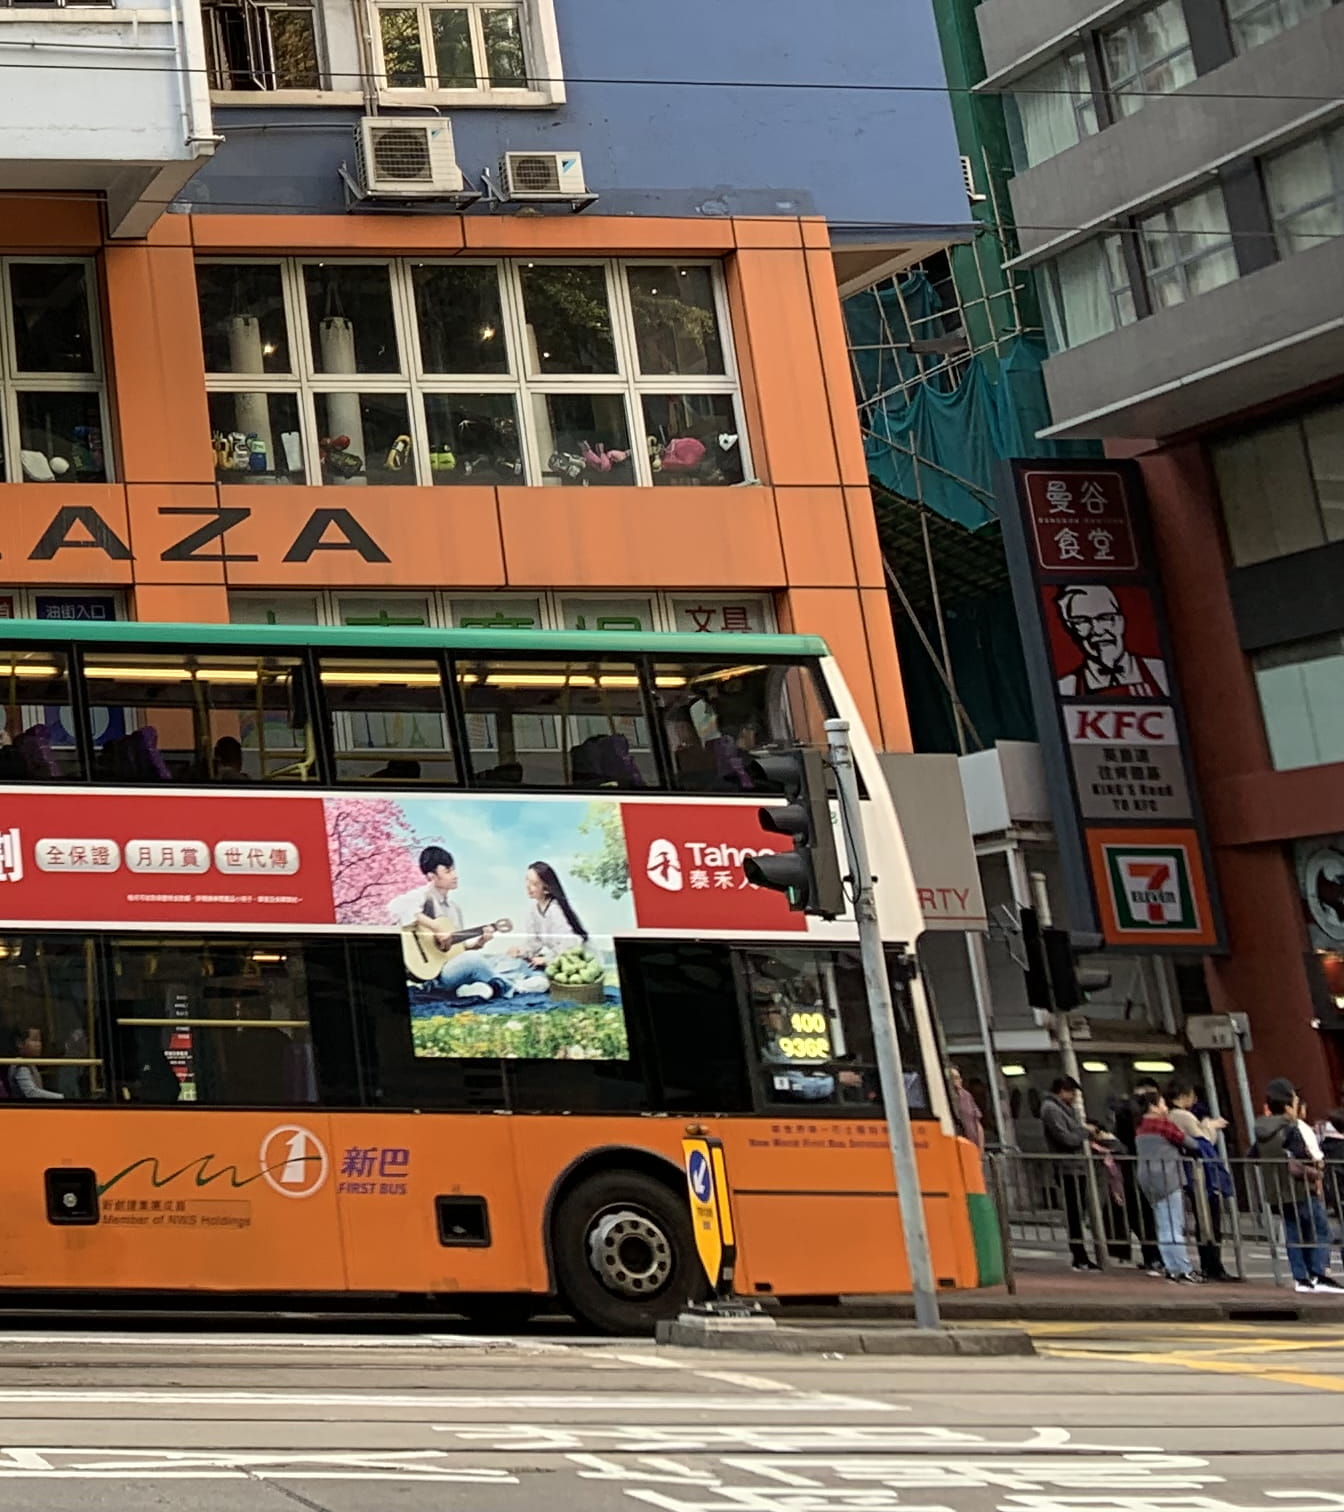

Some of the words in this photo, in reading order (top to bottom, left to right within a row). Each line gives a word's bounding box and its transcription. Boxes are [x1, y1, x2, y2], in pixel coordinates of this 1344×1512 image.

[1046, 480, 1108, 514] 曼谷
[1054, 528, 1116, 561] 食堂
[1075, 711, 1165, 739] KFC
[46, 846, 111, 866] 全保證
[136, 846, 201, 867] 月月賞
[224, 848, 289, 868] 世代傳
[684, 842, 776, 867] Tah
[1126, 863, 1171, 924] 7
[341, 1146, 410, 1178] 新巴
[336, 1182, 376, 1194] FIRST
[379, 1183, 408, 1195] BUS
